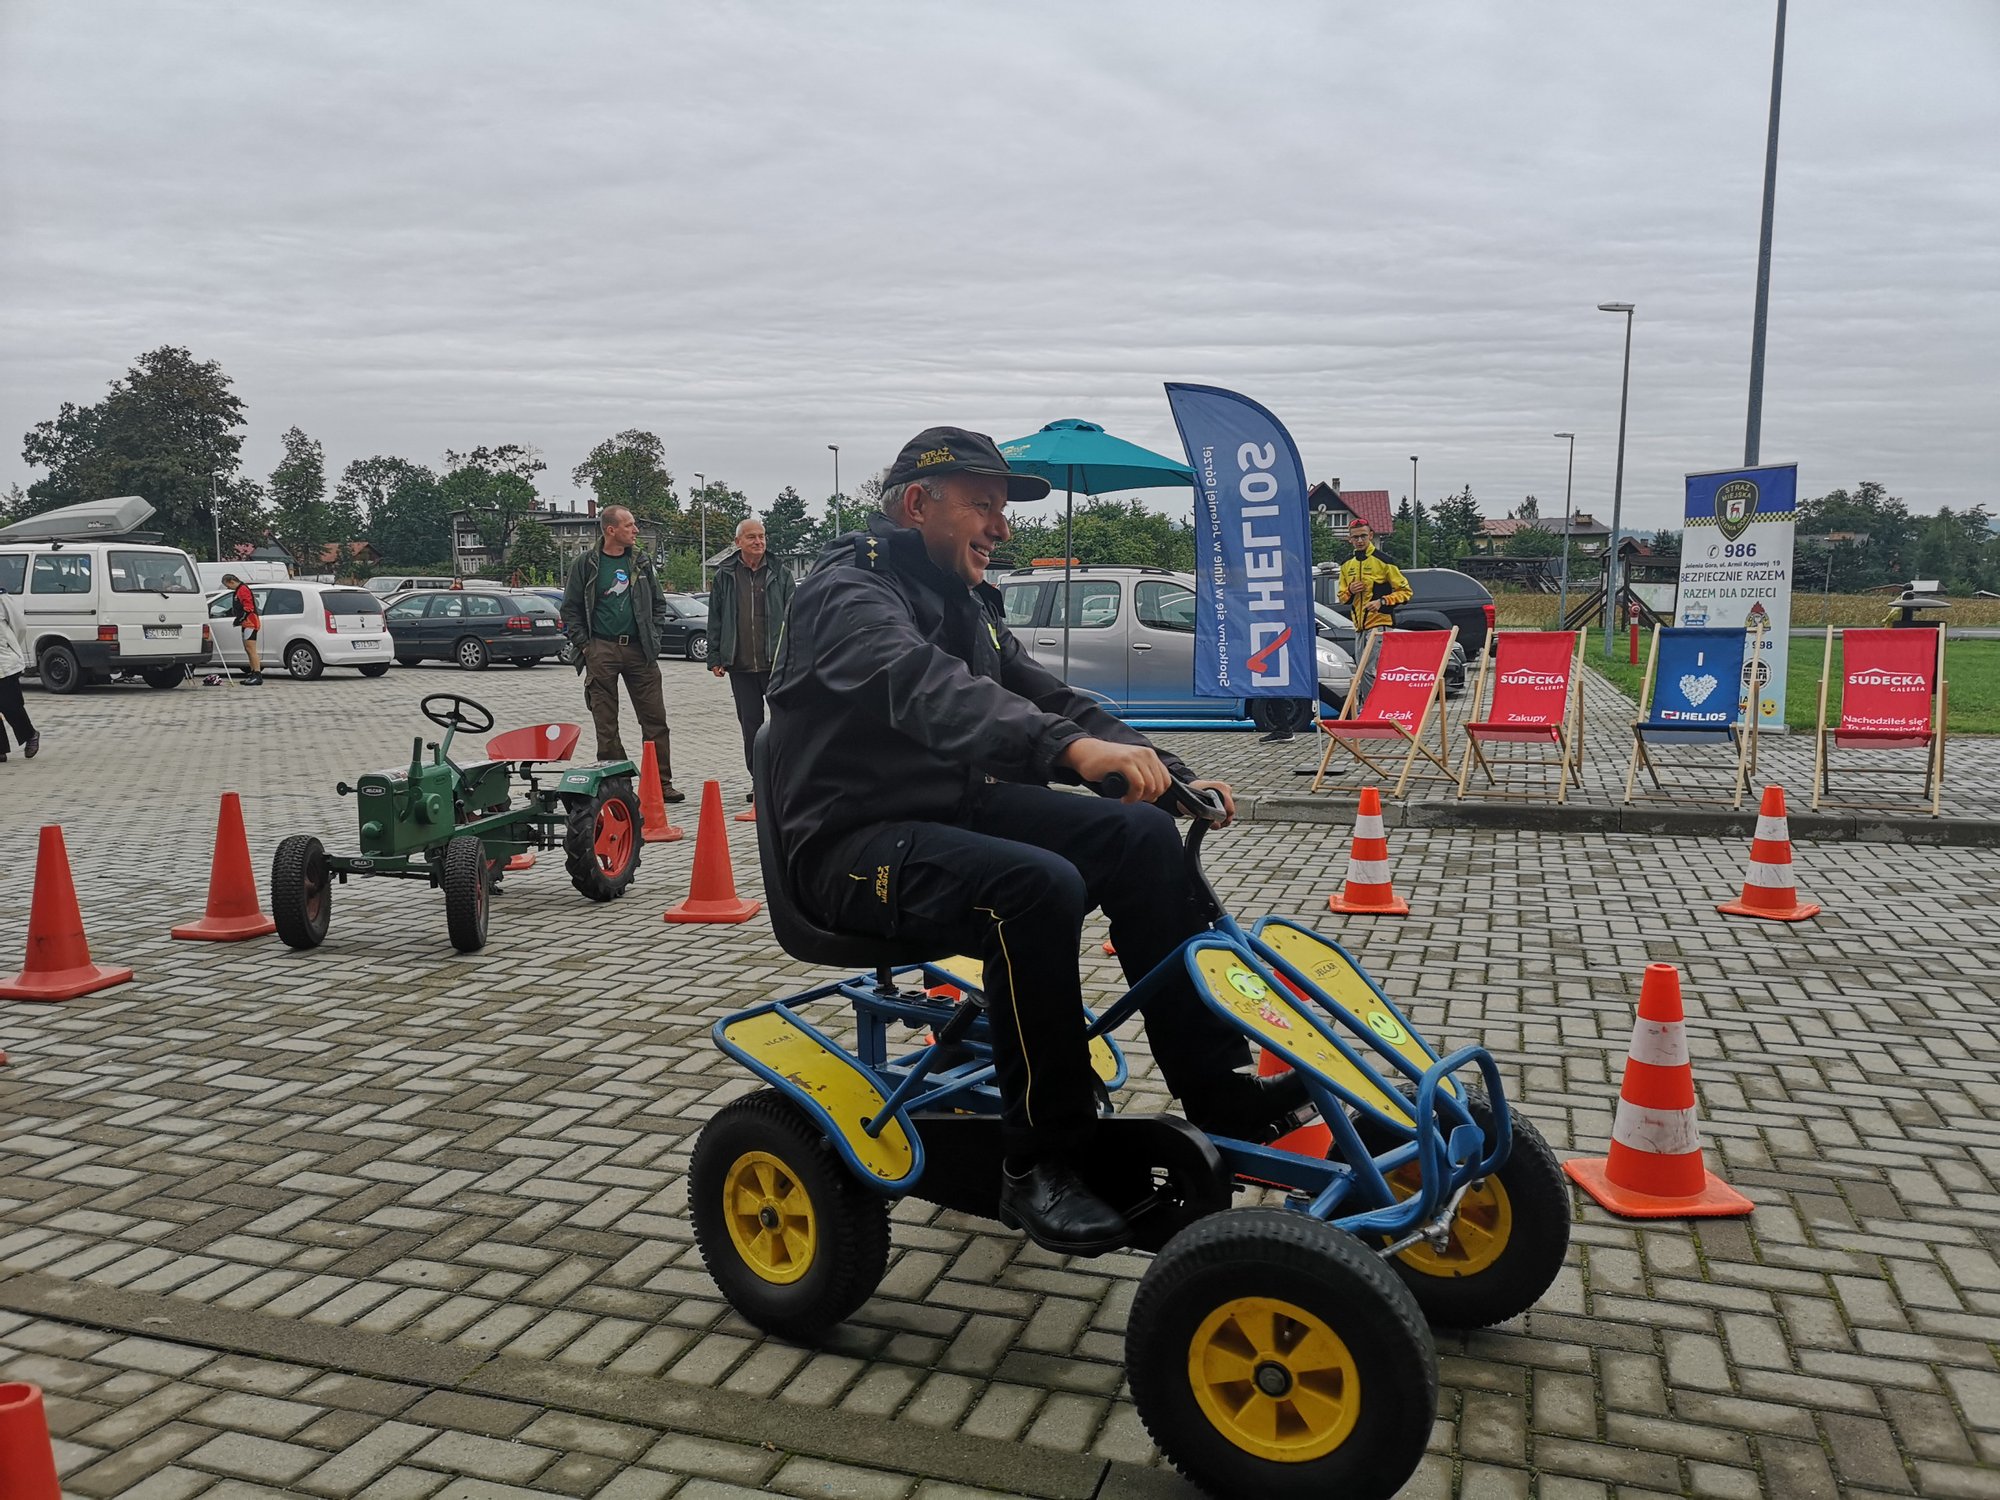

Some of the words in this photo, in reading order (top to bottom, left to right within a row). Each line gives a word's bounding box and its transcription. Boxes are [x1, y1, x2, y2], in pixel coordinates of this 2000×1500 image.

[916, 454, 956, 468] MIEJSKA
[1722, 491, 1751, 501] MIEJSKA
[1724, 543, 1757, 557] 986
[1744, 560, 1769, 568] Krajowej
[1680, 571, 1743, 582] BEZPIECZNIE
[1746, 570, 1785, 581] RAZEM
[1683, 588, 1716, 598] RAZEM
[1720, 588, 1737, 598] DLA
[1740, 587, 1776, 598] DZIECI
[1697, 652, 1704, 666] I
[1380, 672, 1435, 682] SUDECKA
[1500, 675, 1565, 684] SUDECKA
[1848, 675, 1926, 685] SUDECKA
[1378, 709, 1413, 720] Leżak
[1507, 713, 1547, 723] Zakupy
[1681, 711, 1727, 721] HELIOS
[1843, 714, 1906, 725] Nachodziłeś
[1908, 717, 1928, 726] się?
